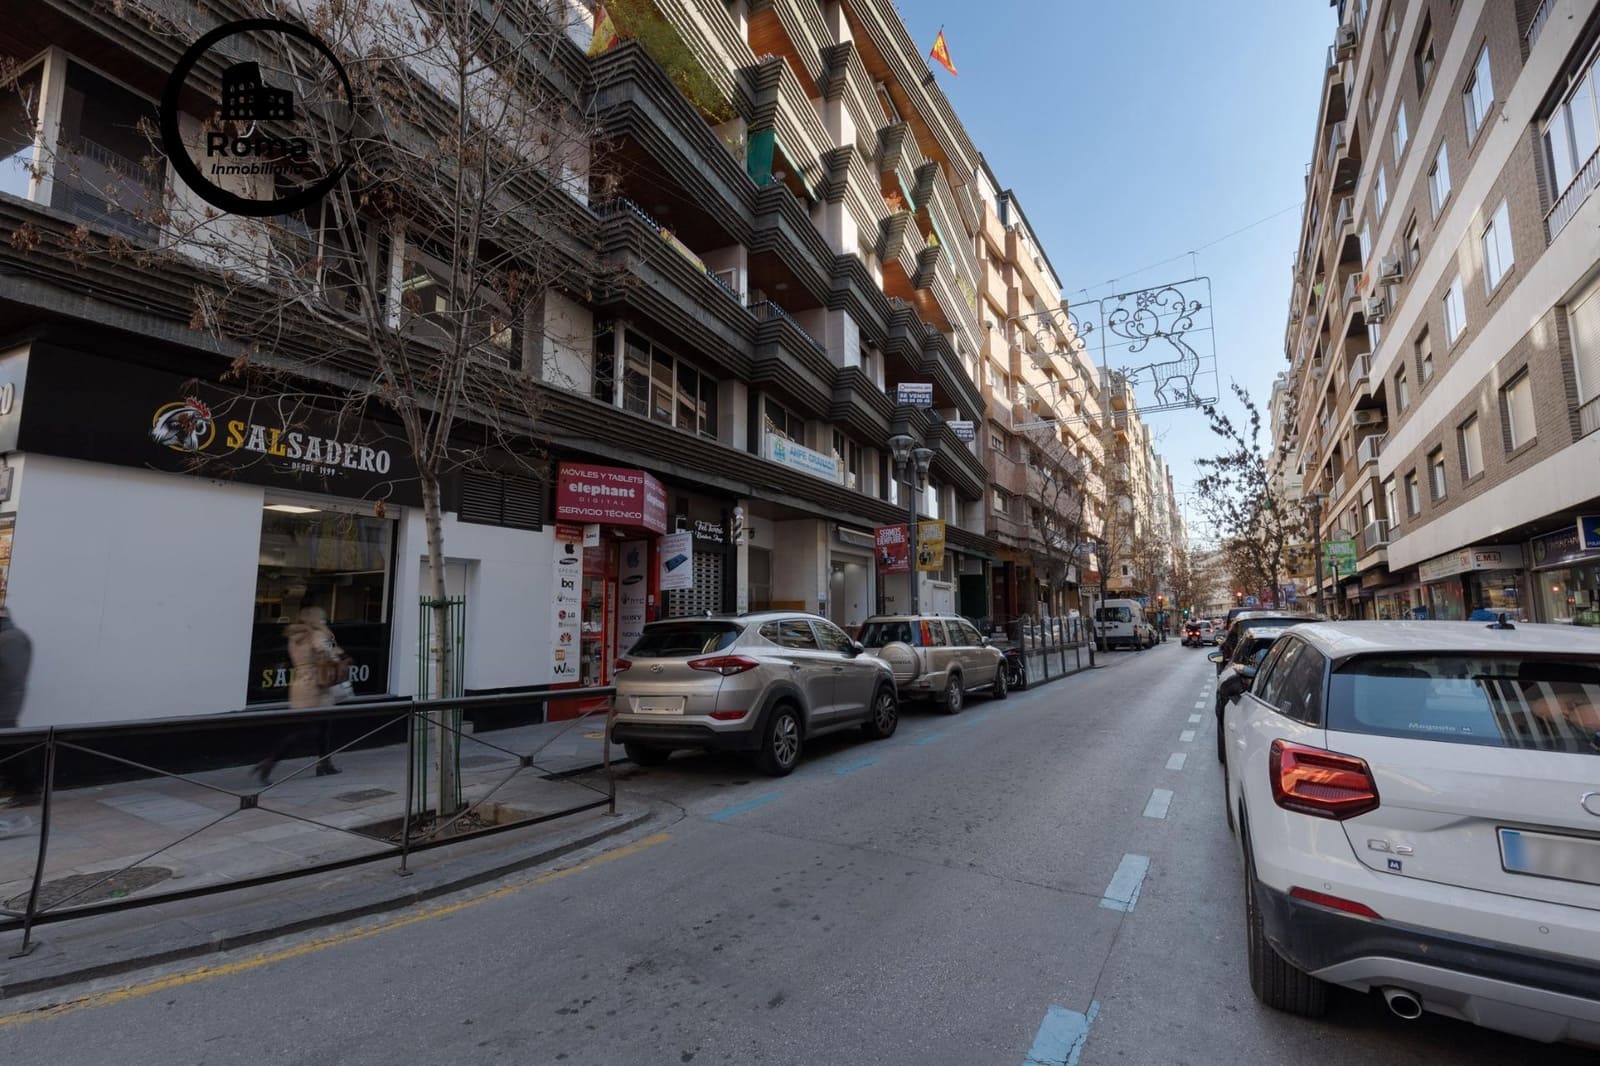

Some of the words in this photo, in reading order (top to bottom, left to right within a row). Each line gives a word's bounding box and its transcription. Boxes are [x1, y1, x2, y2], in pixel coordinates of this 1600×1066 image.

[226, 420, 391, 474] SALSADERO
[608, 473, 644, 485] TABLETS
[569, 482, 636, 499] elephant
[579, 496, 625, 507] DIGITAL
[558, 506, 603, 516] SERVICIO
[561, 578, 574, 591] bq
[1367, 839, 1414, 857] Q2
